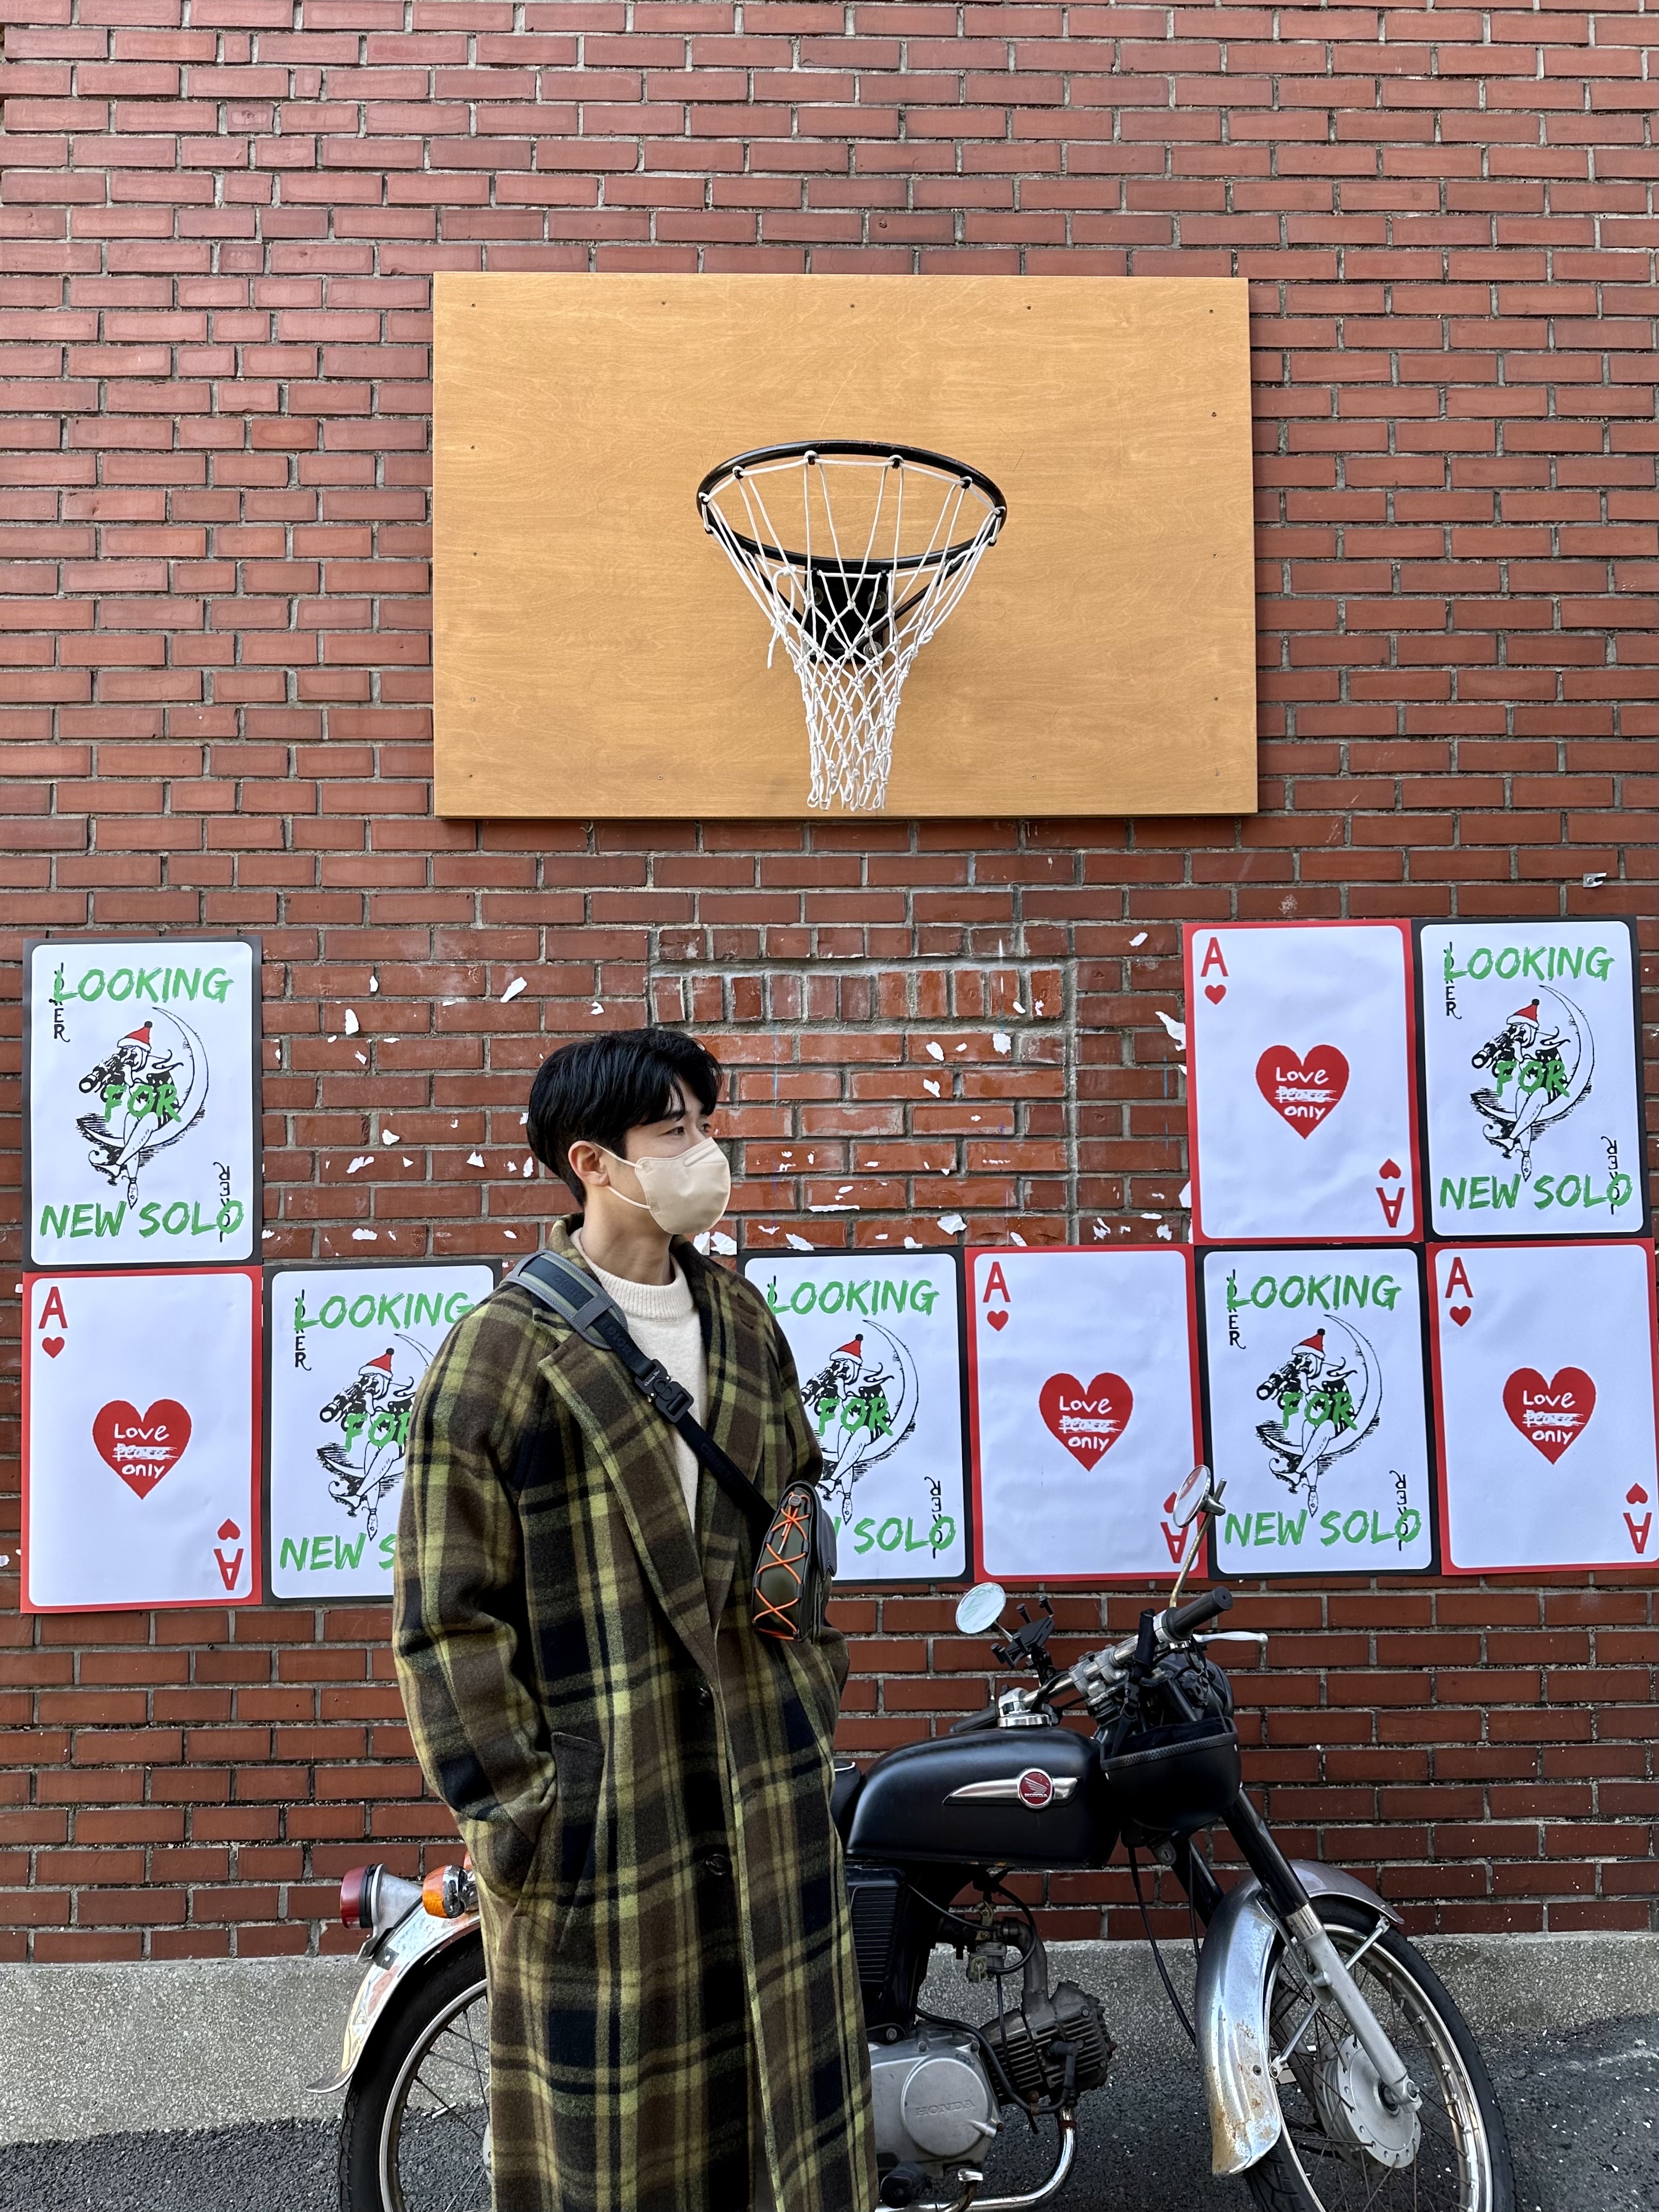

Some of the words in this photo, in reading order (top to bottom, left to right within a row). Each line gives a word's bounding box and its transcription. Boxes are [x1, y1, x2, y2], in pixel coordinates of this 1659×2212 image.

[1200, 937, 1228, 977] A
[1444, 946, 1615, 982] LOOKING
[53, 968, 233, 1004] LOOKING
[1276, 1066, 1329, 1085] Love
[1495, 1058, 1570, 1097] FOR
[104, 1083, 181, 1122] FOR
[1284, 1106, 1326, 1120] only
[1376, 1187, 1405, 1228] A
[1440, 1174, 1522, 1210] NEW
[1534, 1174, 1633, 1210] SOLO
[40, 1201, 126, 1239] NEW
[139, 1200, 244, 1238] SOLO
[983, 1261, 1011, 1303] A
[1227, 1275, 1402, 1311] LOOKING
[1445, 1257, 1473, 1298] A
[38, 1286, 68, 1329] A
[294, 1292, 476, 1332] LOOKING
[766, 1280, 940, 1317] LOOKING
[818, 1395, 893, 1436] FOR
[1060, 1395, 1113, 1414] Love
[1281, 1390, 1357, 1430] FOR
[1523, 1390, 1576, 1409] Love
[114, 1423, 169, 1442] Love
[1068, 1436, 1110, 1451] only
[1532, 1429, 1573, 1445] only
[121, 1463, 165, 1479] only
[854, 1516, 956, 1554] SOLO
[1224, 1511, 1308, 1546] NEW
[1320, 1509, 1422, 1546] SOLO
[1623, 1512, 1652, 1555] A
[213, 1548, 244, 1591] A
[279, 1533, 366, 1571] NEW
[914, 2099, 977, 2118] HONDA
